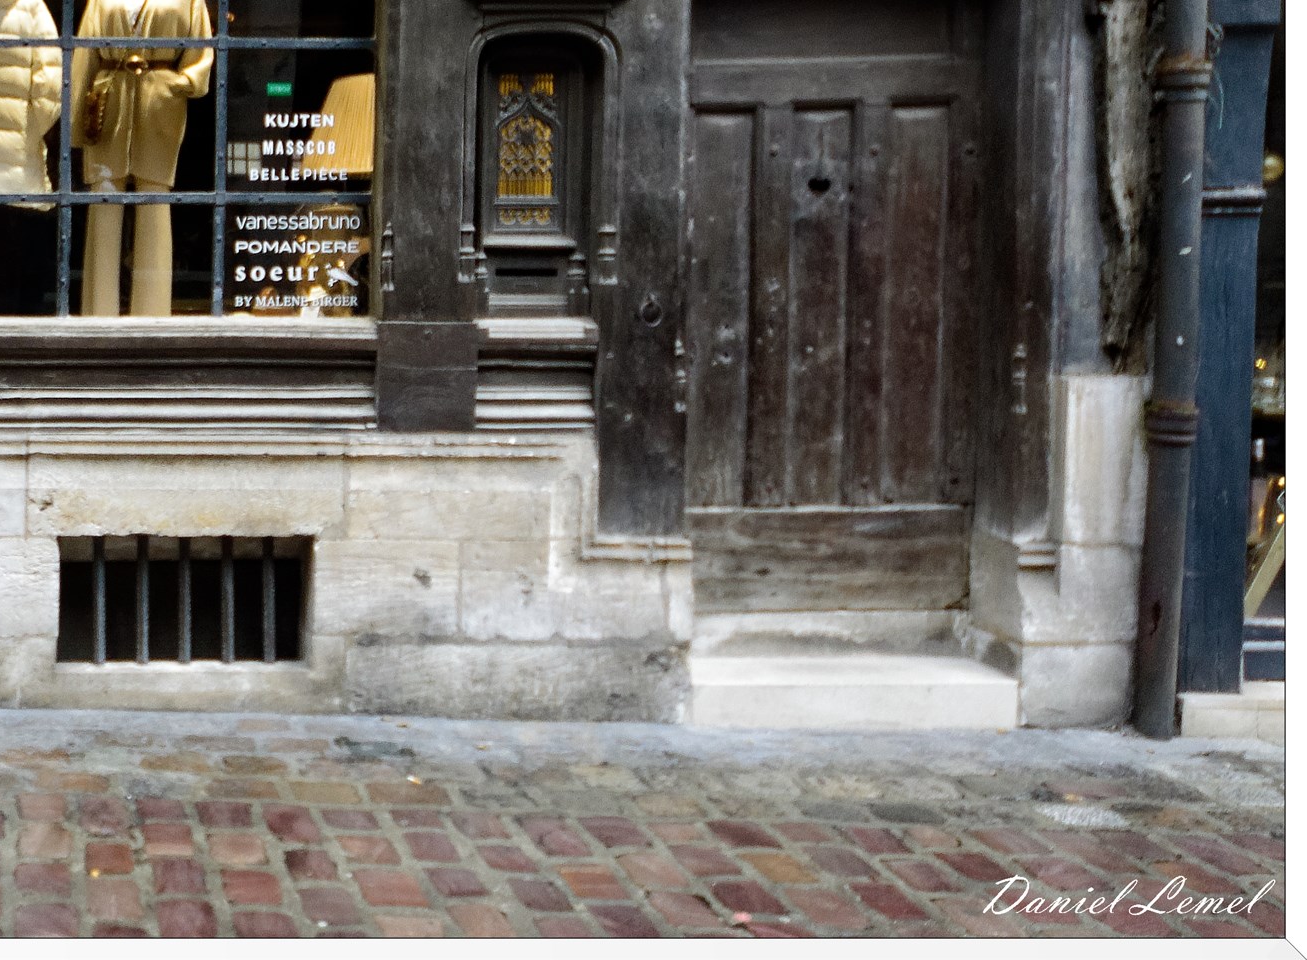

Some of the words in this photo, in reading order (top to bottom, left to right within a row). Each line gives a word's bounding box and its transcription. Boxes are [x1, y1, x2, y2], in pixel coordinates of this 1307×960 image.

[264, 113, 335, 129] KUJTEN
[262, 139, 336, 156] MASSCOB
[235, 211, 361, 231] vanessabruno
[234, 240, 360, 255] POMANDERE
[234, 264, 319, 283] soeur
[234, 295, 253, 308] BY
[255, 295, 309, 308] MALENE
[312, 295, 359, 308] BIRGER
